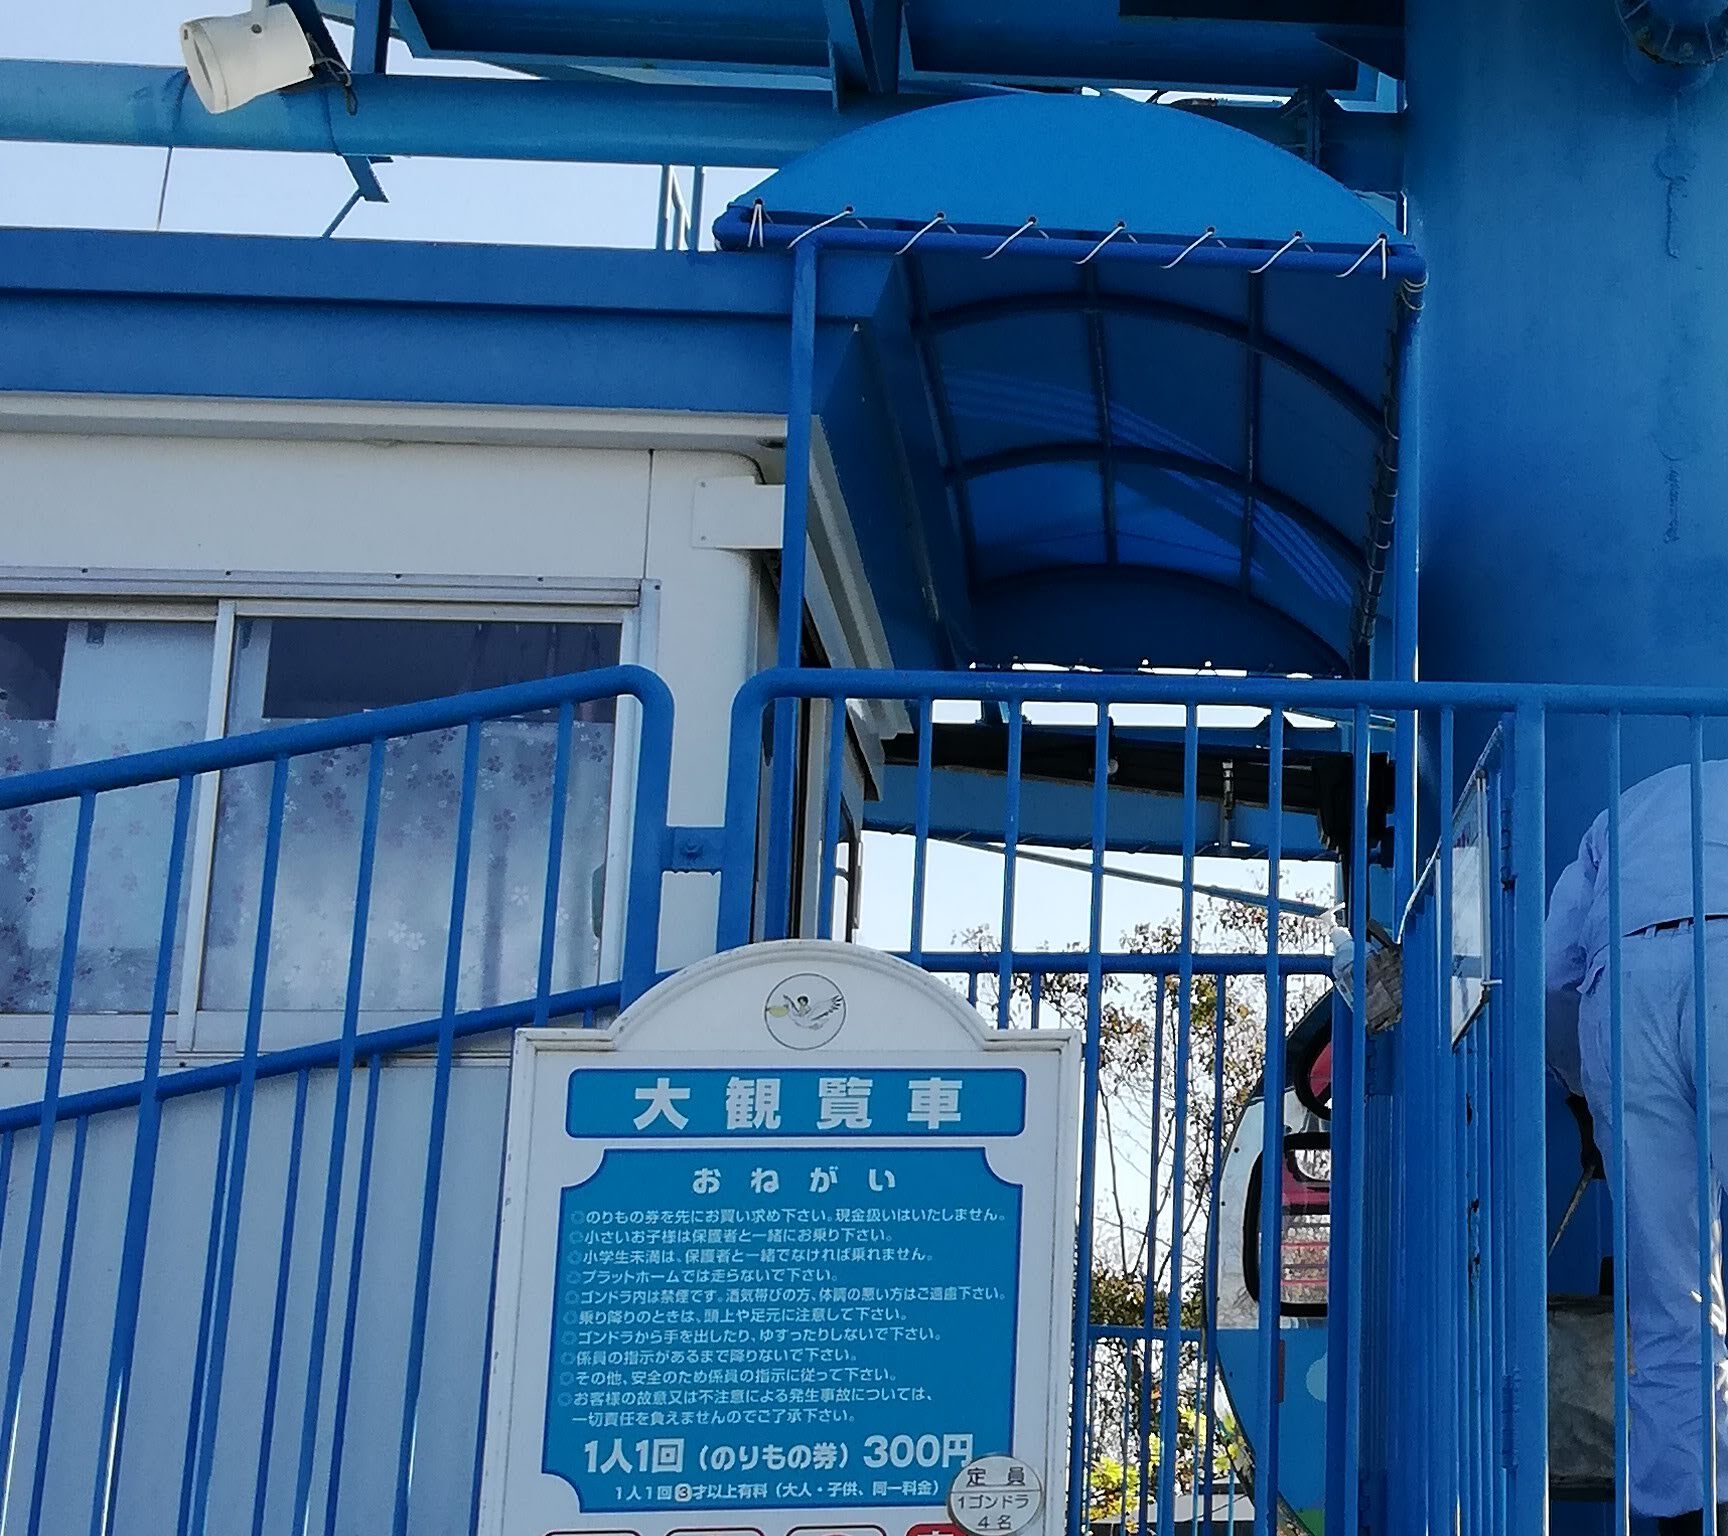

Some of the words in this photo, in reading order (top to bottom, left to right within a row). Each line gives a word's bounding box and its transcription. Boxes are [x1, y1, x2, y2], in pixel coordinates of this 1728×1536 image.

[633, 1077, 963, 1130] 大観覧車
[692, 1165, 897, 1194] おねがい
[966, 1467, 1026, 1486] 定員
